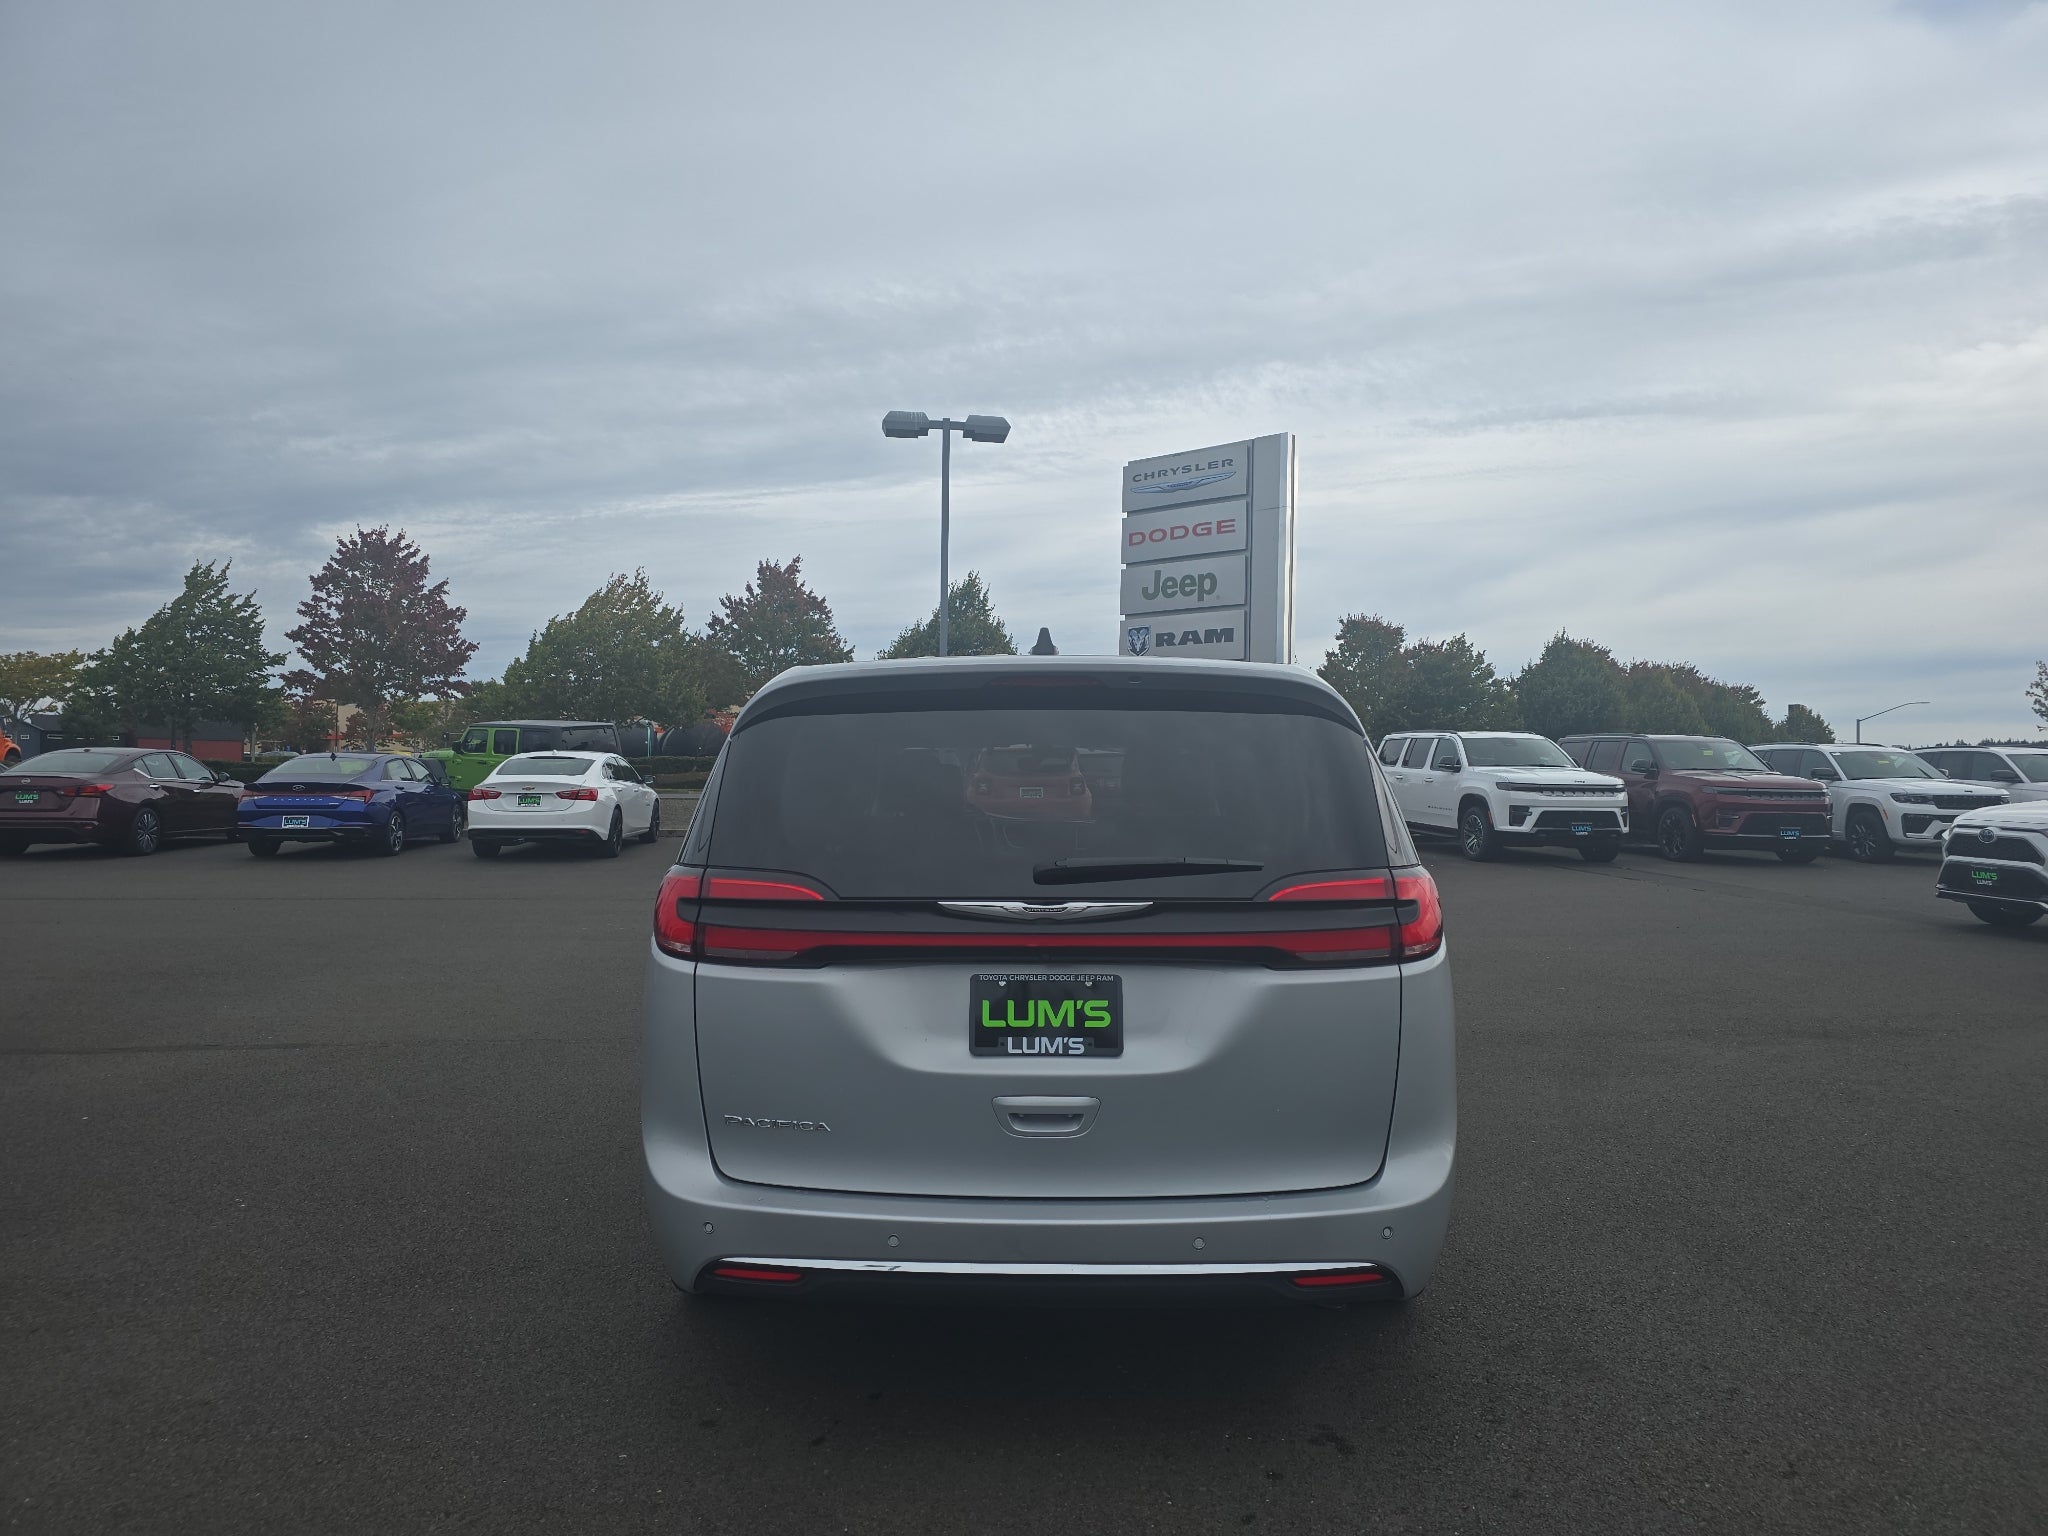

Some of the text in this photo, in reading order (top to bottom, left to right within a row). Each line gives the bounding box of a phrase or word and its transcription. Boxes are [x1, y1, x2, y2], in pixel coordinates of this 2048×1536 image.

[1132, 458, 1234, 483] CHRYSLER
[1128, 518, 1236, 547] DODGE
[1141, 570, 1218, 602] Jeep
[1155, 628, 1235, 648] RAM
[1076, 974, 1096, 982] JEEP
[982, 999, 1112, 1028] LUM'S
[1007, 1036, 1085, 1055] LUM'S
[724, 1114, 831, 1132] PACIFICA
